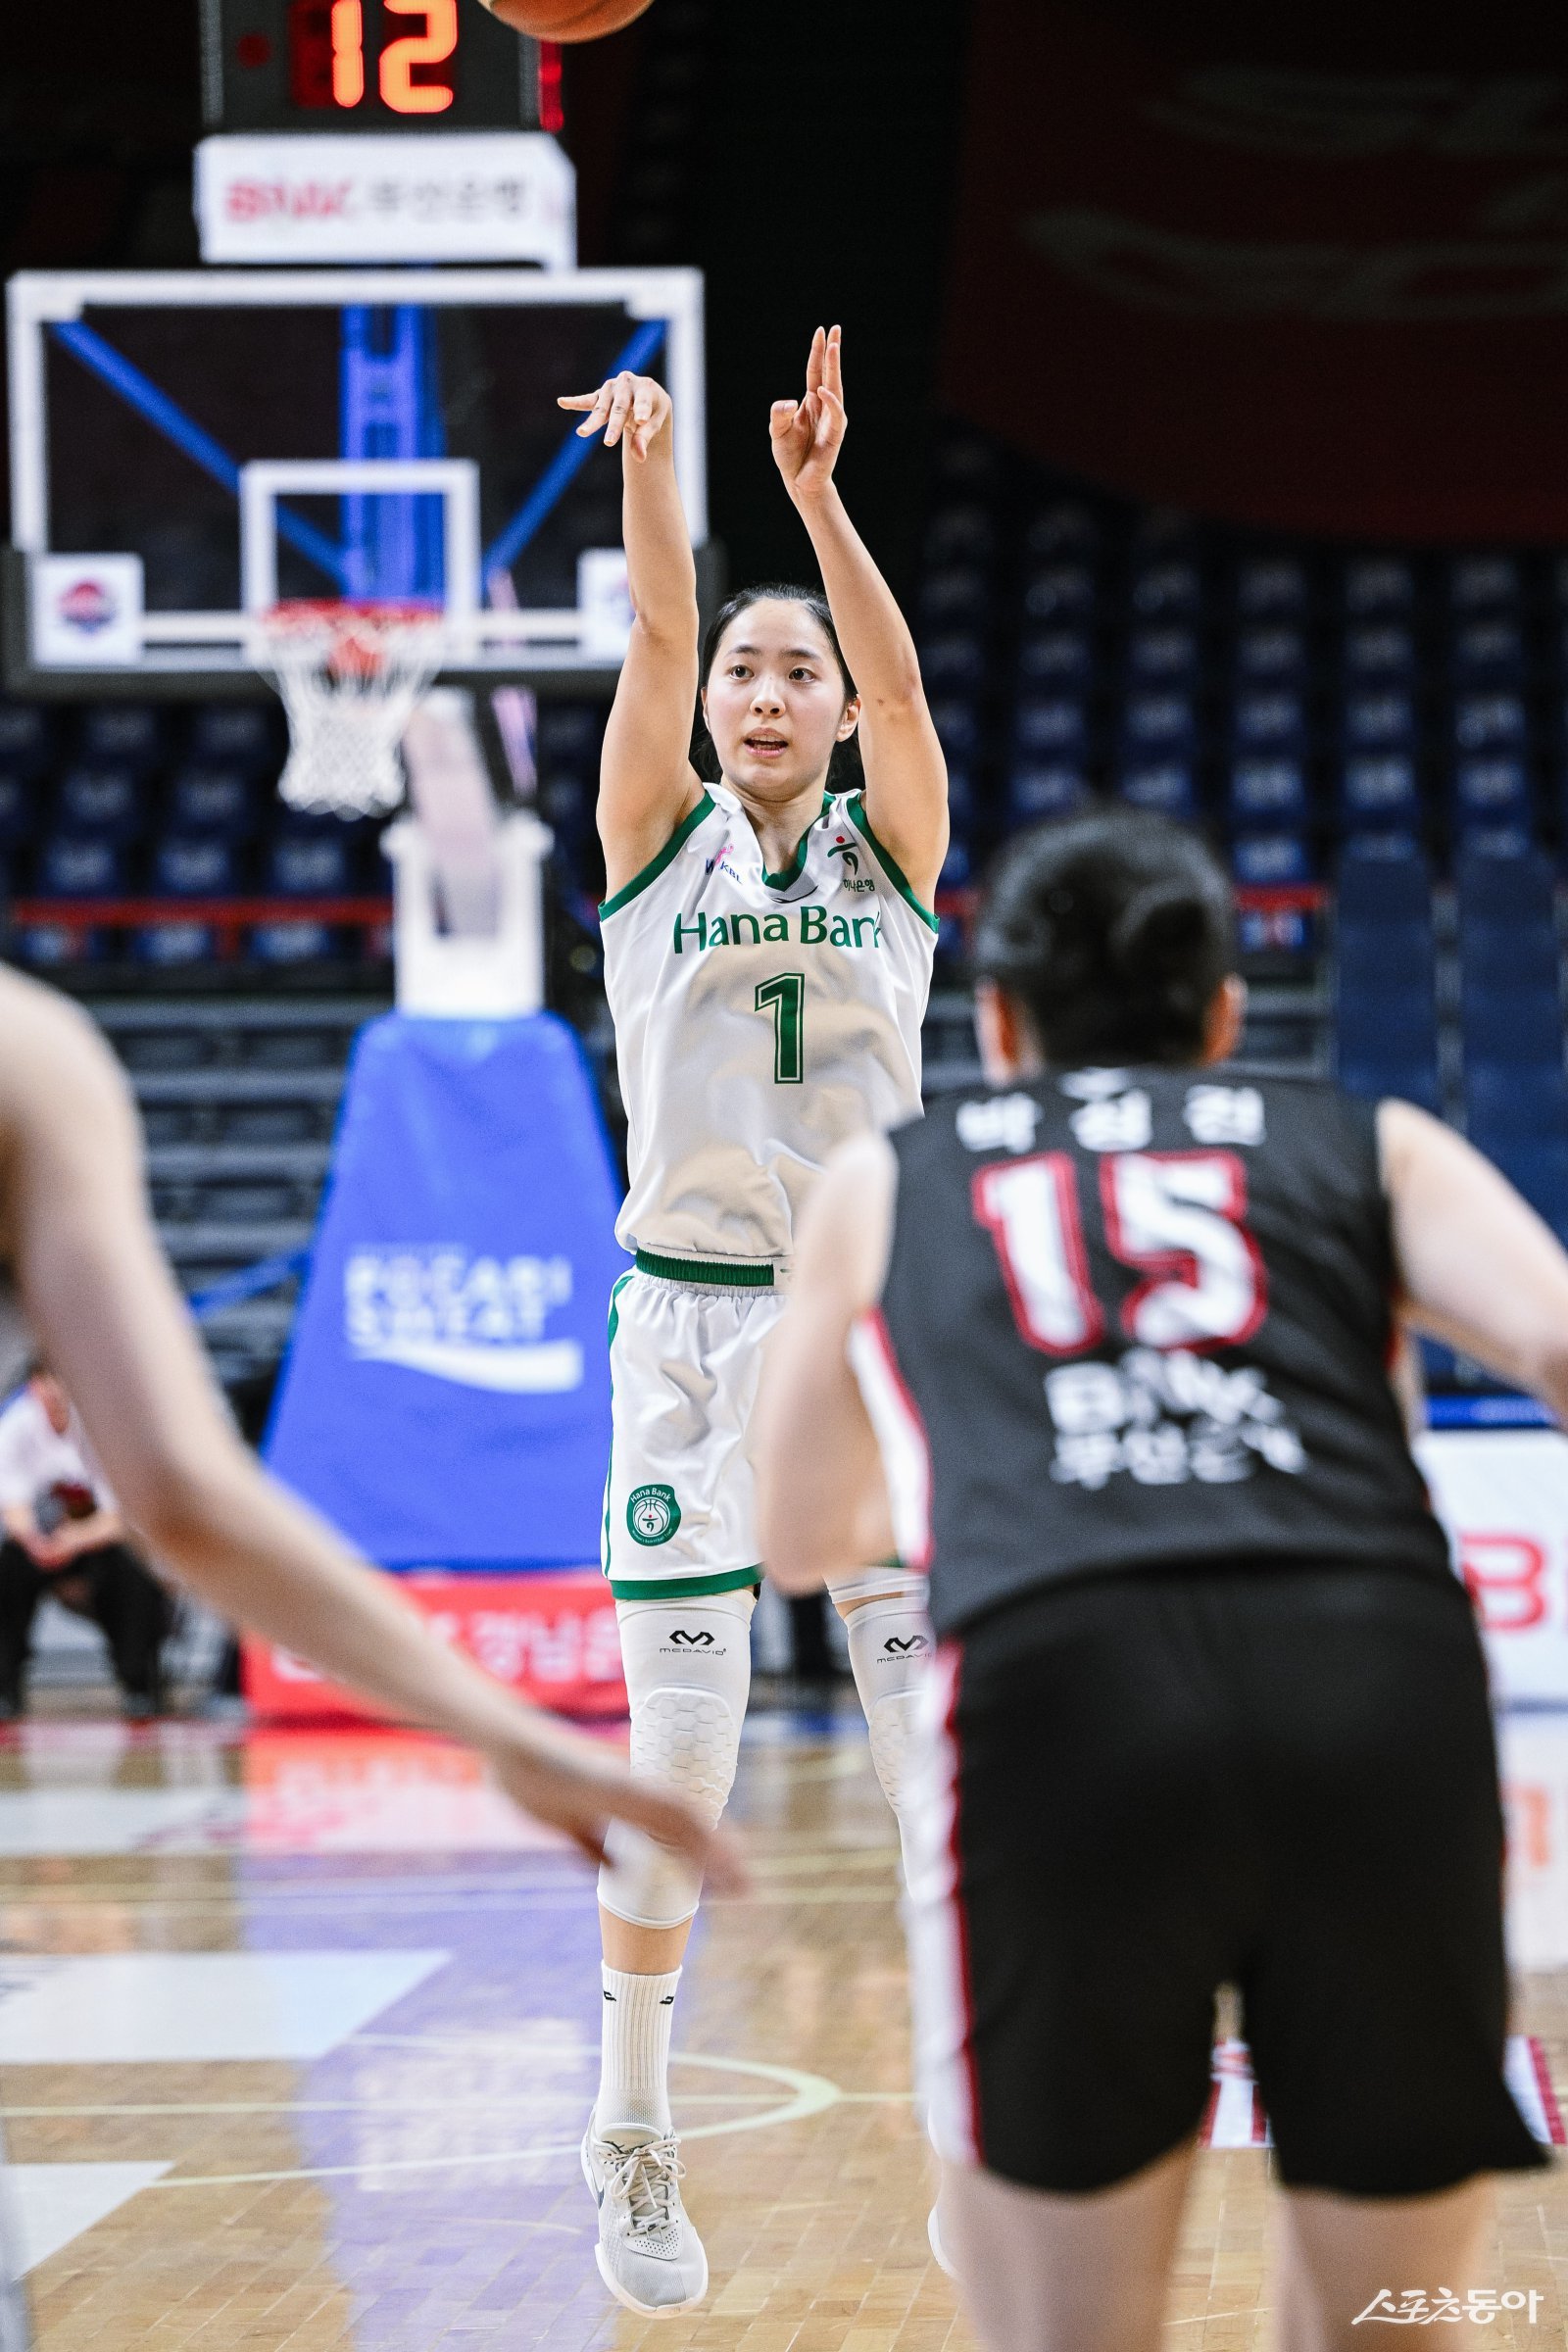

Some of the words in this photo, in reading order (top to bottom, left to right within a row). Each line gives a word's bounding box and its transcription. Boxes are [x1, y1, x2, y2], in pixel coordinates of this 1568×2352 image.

[331, 0, 457, 113] 12
[673, 910, 789, 954] Hana
[755, 972, 805, 1084] 1
[971, 1149, 1268, 1357] 15
[630, 1489, 650, 1502] Hana
[652, 1488, 671, 1502] Bank
